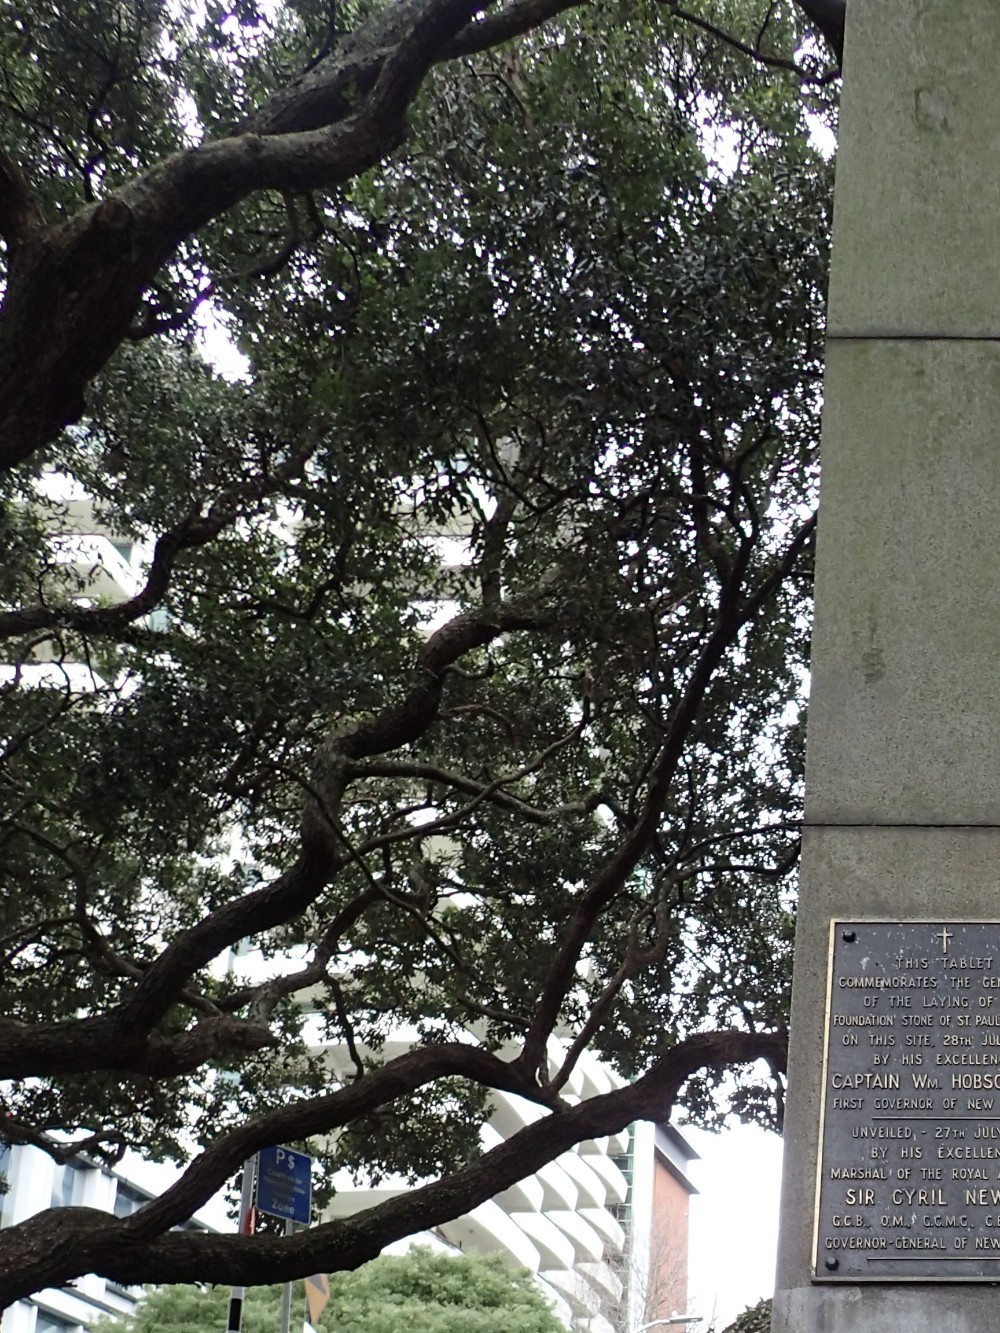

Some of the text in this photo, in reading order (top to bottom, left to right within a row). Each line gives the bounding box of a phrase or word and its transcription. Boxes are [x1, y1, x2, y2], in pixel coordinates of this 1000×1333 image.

[896, 956, 993, 969] THIS TABLET
[839, 976, 937, 989] COMMEMORATES
[950, 976, 971, 989] THE
[889, 996, 912, 1008] THE
[922, 996, 968, 1008] LAYING
[833, 1015, 894, 1026] FOUNDATION
[902, 1015, 933, 1026] STONE
[957, 1015, 972, 1026] ST.
[868, 1034, 895, 1046] THIS
[902, 1054, 923, 1066] HIS
[832, 1073, 900, 1090] CAPTAIN
[833, 1099, 864, 1110] FIRST
[874, 1099, 933, 1110] GOVERNOR
[967, 1099, 994, 1110] NEW
[901, 1147, 923, 1159] HIS
[830, 1168, 886, 1180] MARSHAL
[921, 1168, 942, 1180] THE
[952, 1168, 988, 1180] ROYAL
[846, 1189, 875, 1206] SIR
[892, 1189, 948, 1206] CYRIL
[272, 1200, 294, 1215] Zone
[825, 1237, 946, 1249] GOVERNOR-GENERAL
